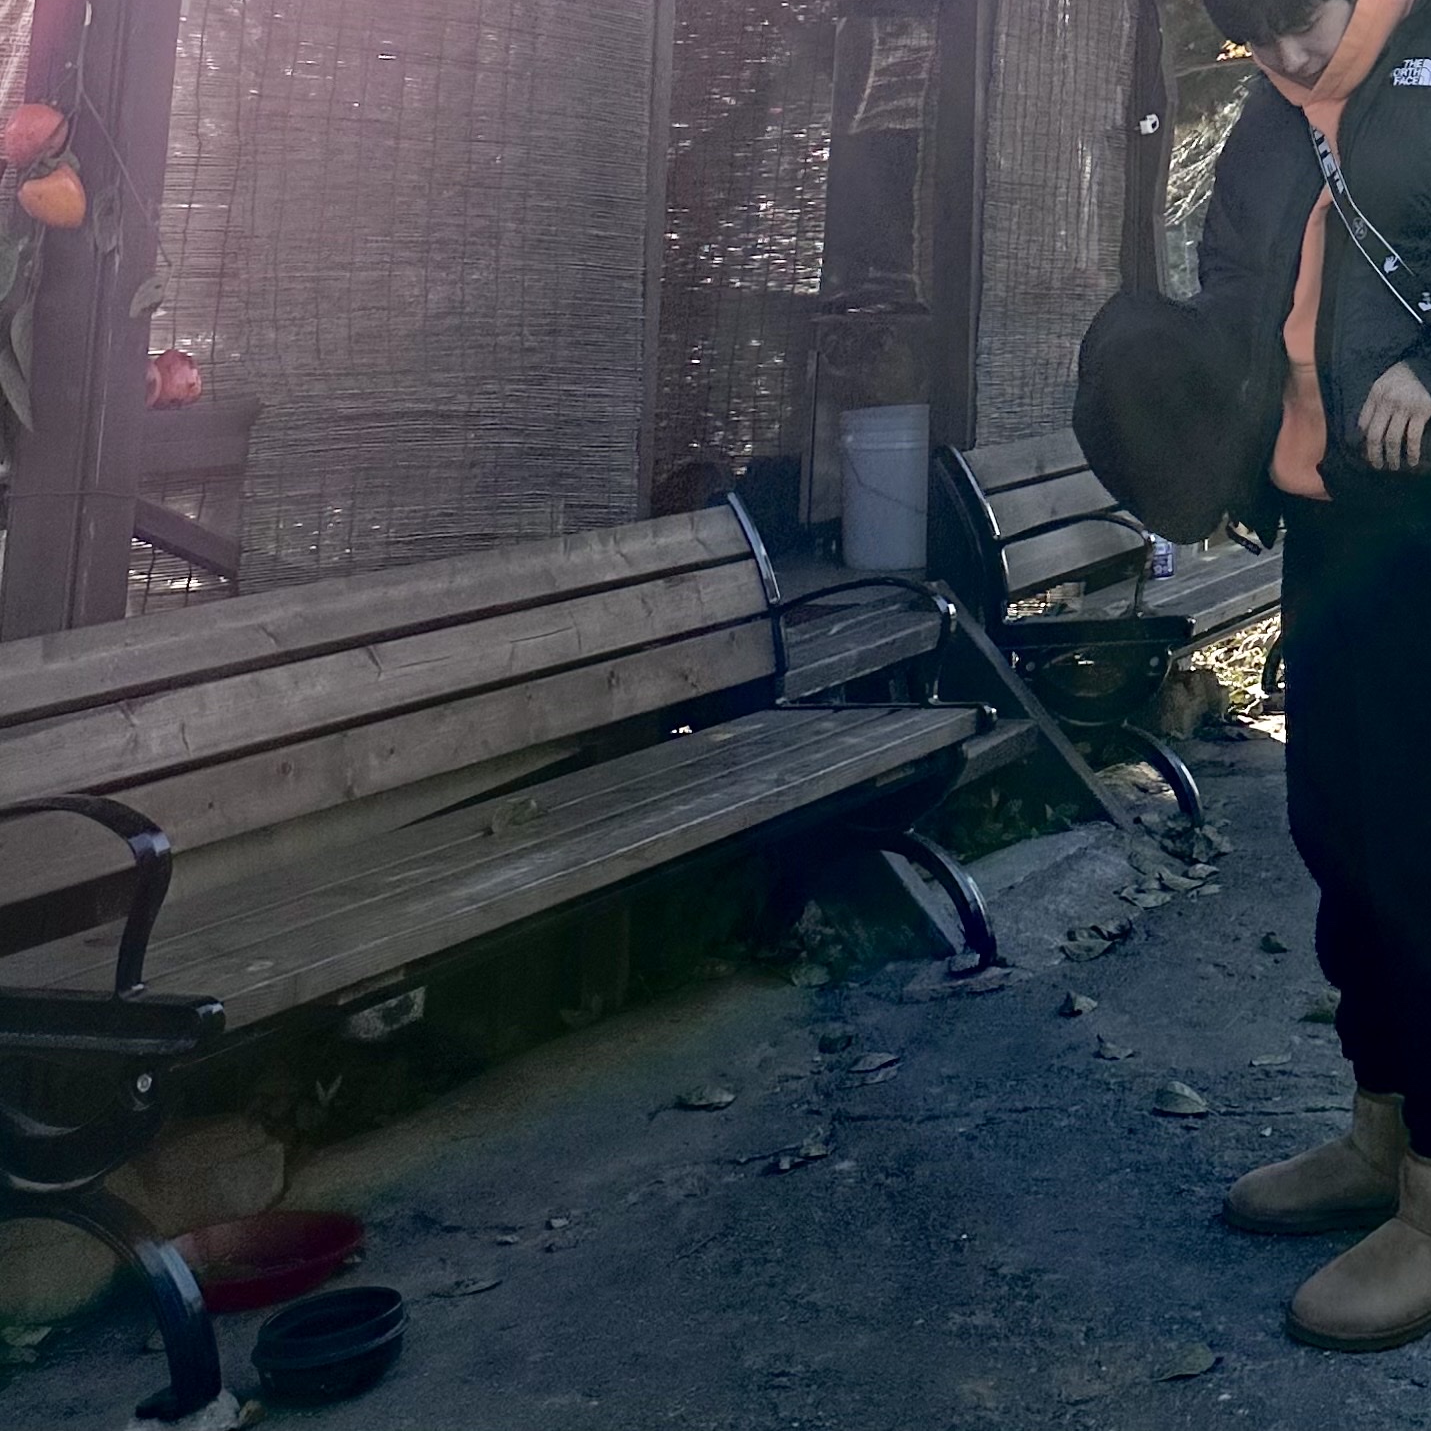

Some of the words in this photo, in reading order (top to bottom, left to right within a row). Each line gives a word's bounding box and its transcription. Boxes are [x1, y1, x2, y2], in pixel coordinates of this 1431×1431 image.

[1403, 59, 1423, 68] THE
[1390, 67, 1422, 77] ORTH
[1393, 76, 1420, 86] FACE
